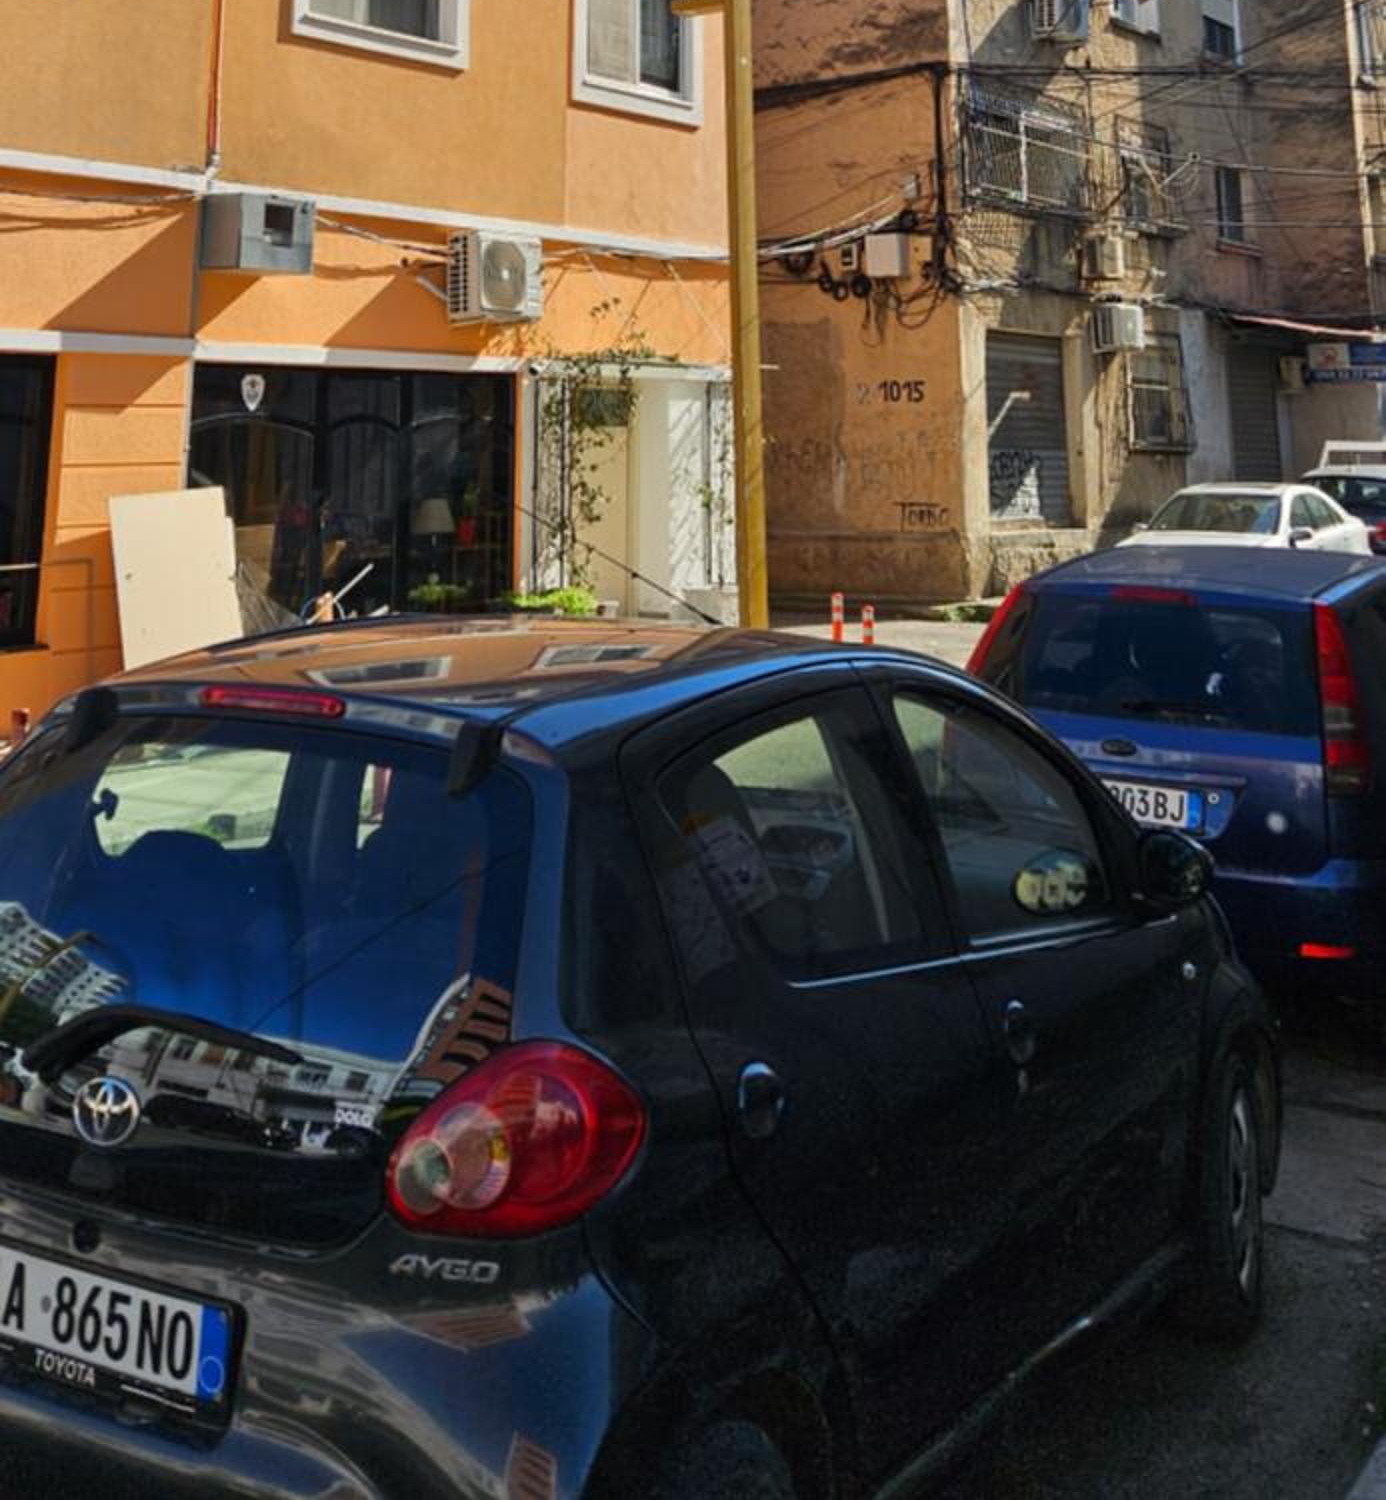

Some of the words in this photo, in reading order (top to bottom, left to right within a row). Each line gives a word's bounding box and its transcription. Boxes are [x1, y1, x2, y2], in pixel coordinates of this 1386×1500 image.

[878, 379, 926, 403] 1015
[389, 1254, 500, 1283] AYGO
[34, 1348, 96, 1386] TOYOTA
